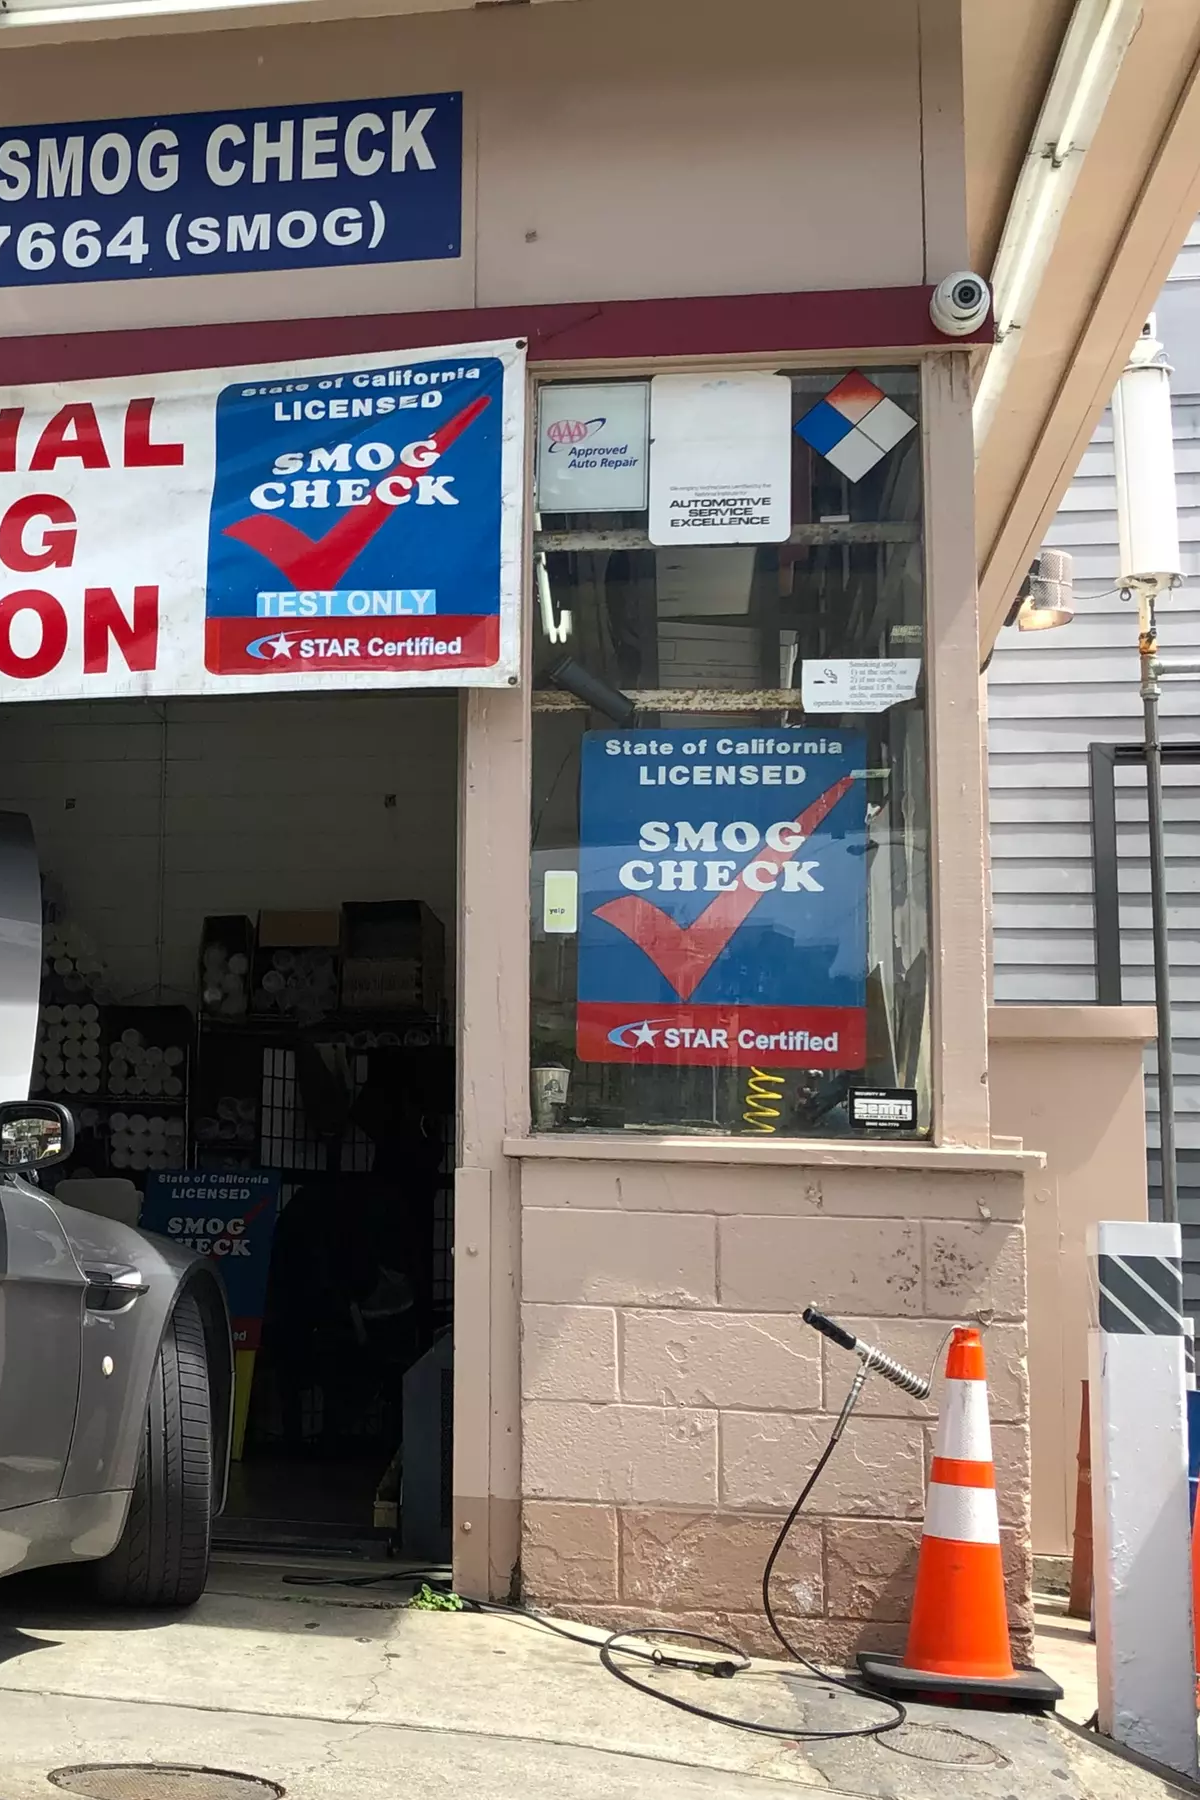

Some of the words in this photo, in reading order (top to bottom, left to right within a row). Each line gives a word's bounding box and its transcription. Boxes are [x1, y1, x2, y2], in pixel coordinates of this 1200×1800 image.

[206, 107, 437, 186] CHECK
[165, 200, 385, 261] (SMOG)
[241, 382, 309, 397] State
[318, 376, 344, 390] of
[352, 367, 481, 388] California
[274, 390, 443, 422] LICENSED
[549, 420, 586, 444] AAA
[272, 437, 441, 476] SMOG
[568, 444, 628, 458] Approved
[568, 459, 597, 468] Auto
[600, 457, 638, 470] Repair
[250, 475, 460, 510] CHECK
[669, 497, 771, 508] AUTOMOTIVE
[670, 516, 770, 527] EXCELLENCE
[688, 507, 753, 517] SERVICE
[261, 591, 338, 617] TEST
[346, 589, 432, 616] ONLY
[299, 638, 361, 658] STAR
[367, 637, 462, 657] Certified
[605, 739, 674, 756] State
[682, 738, 707, 755] of
[716, 738, 843, 756] California
[639, 765, 807, 786] LICENSED
[638, 821, 806, 853] SMOG
[618, 860, 824, 893] CHECK
[663, 1028, 728, 1050] STAR
[738, 1029, 839, 1052] Certified
[158, 1174, 190, 1183] State
[194, 1174, 205, 1183] of
[209, 1174, 269, 1184] California
[171, 1188, 251, 1200] LICENSED
[167, 1217, 247, 1235] SMOG
